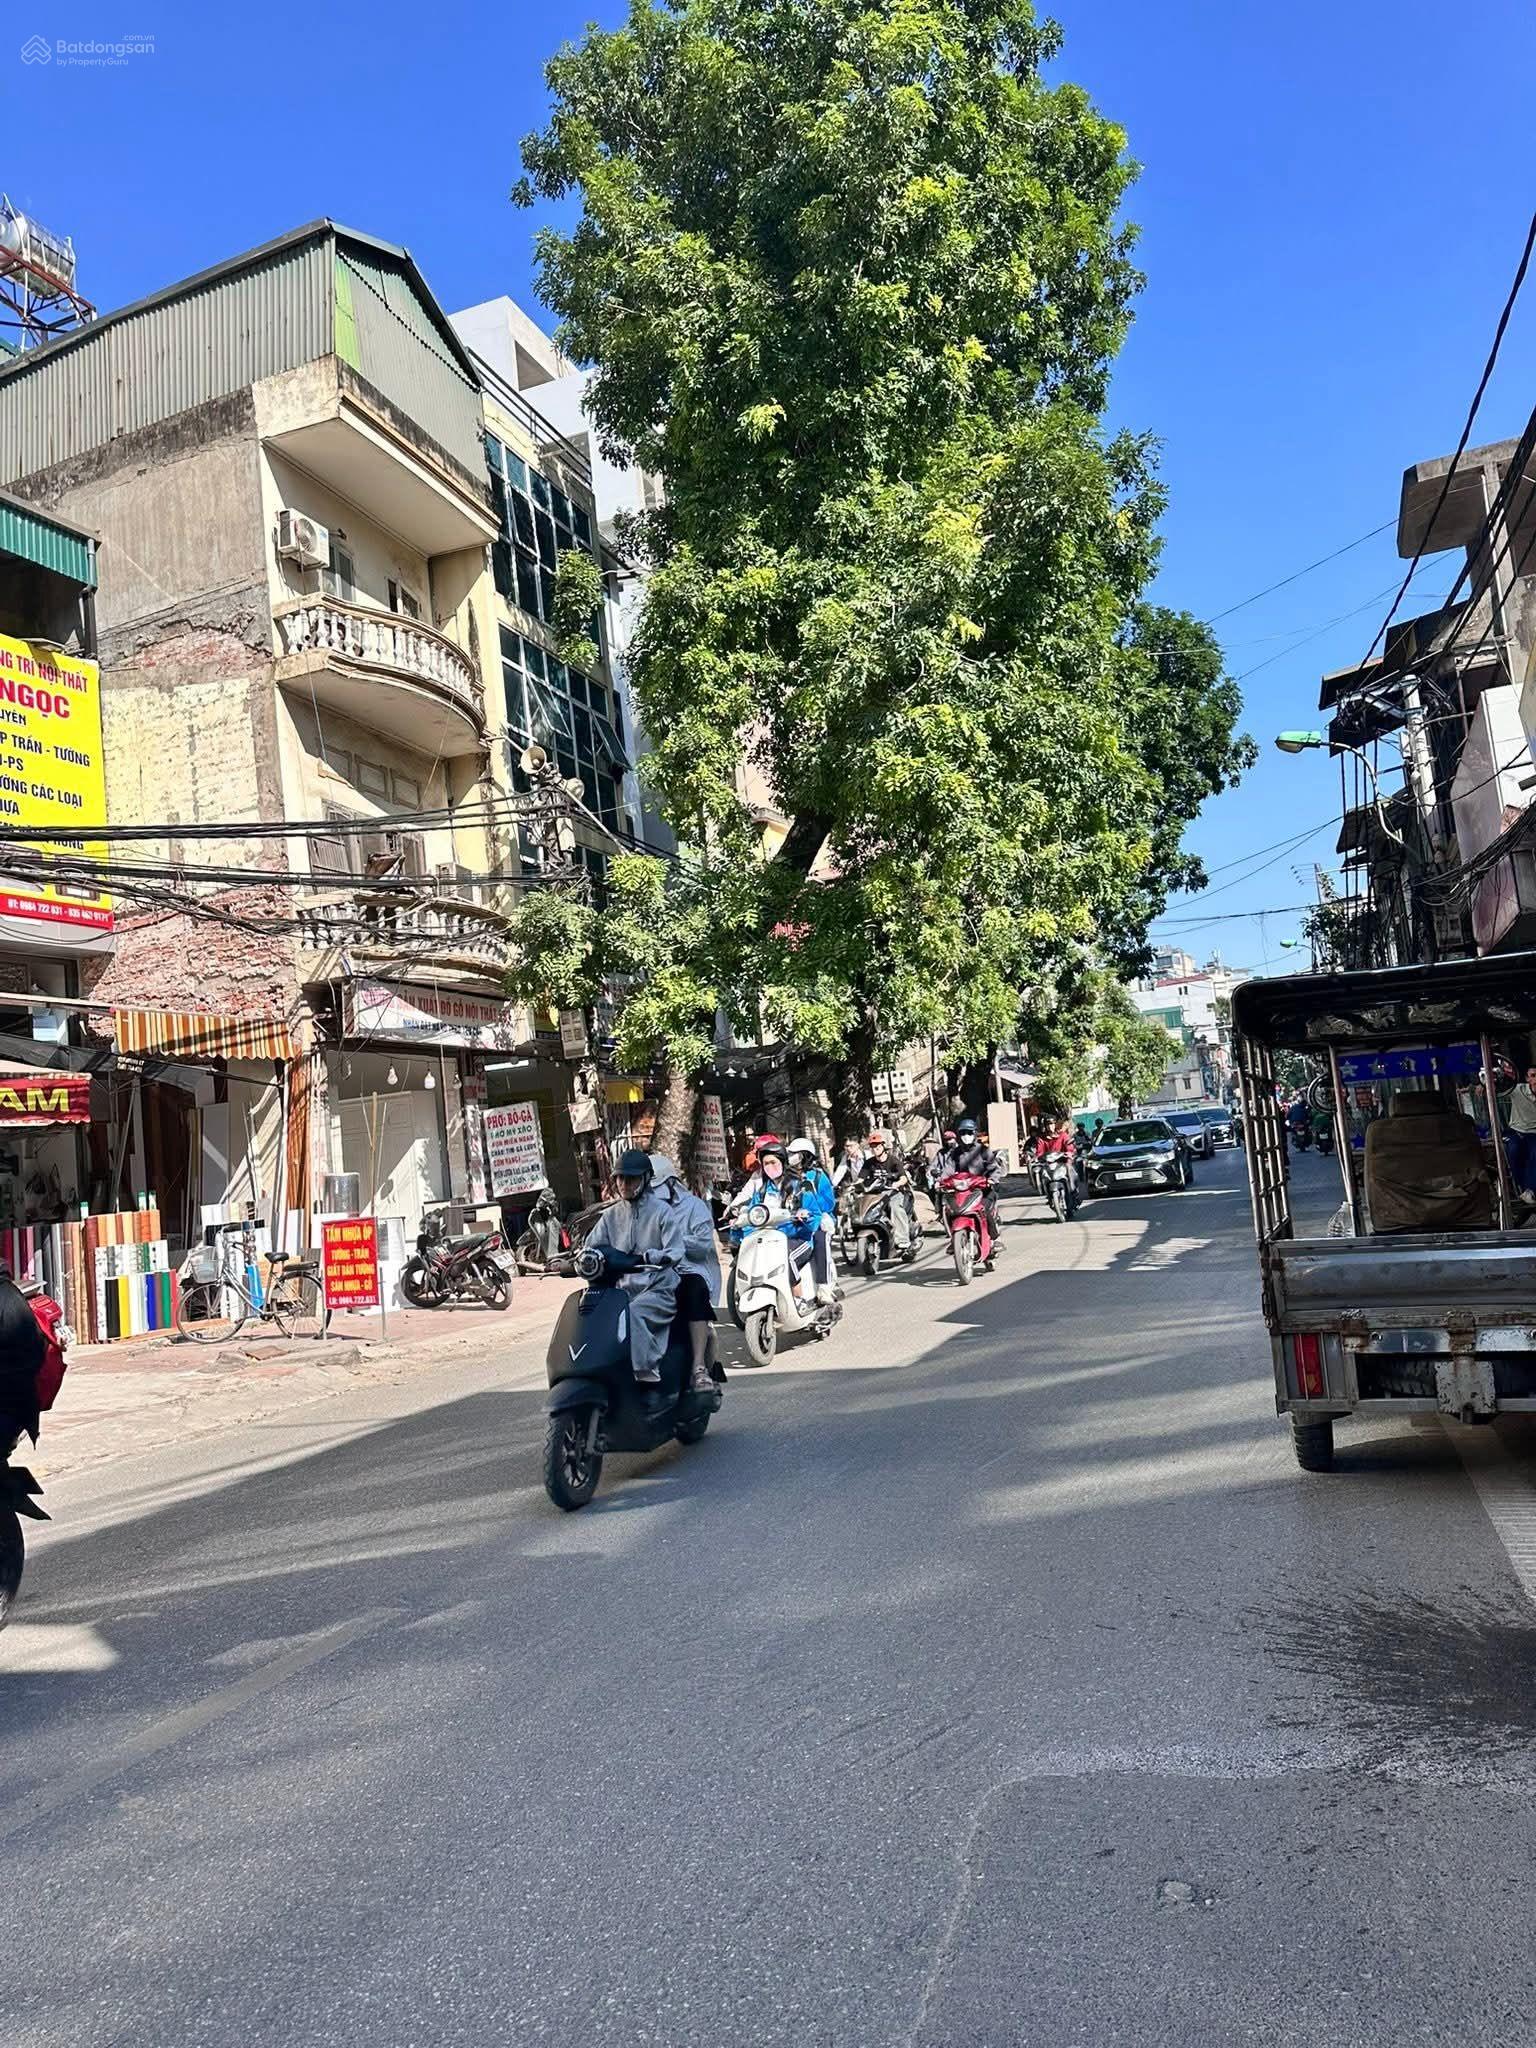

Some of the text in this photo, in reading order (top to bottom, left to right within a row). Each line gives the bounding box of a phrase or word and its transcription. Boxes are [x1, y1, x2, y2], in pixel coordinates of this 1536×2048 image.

[0, 677, 70, 719] NGỌC
[31, 783, 55, 801] CÁC
[57, 790, 82, 808] LOẠI
